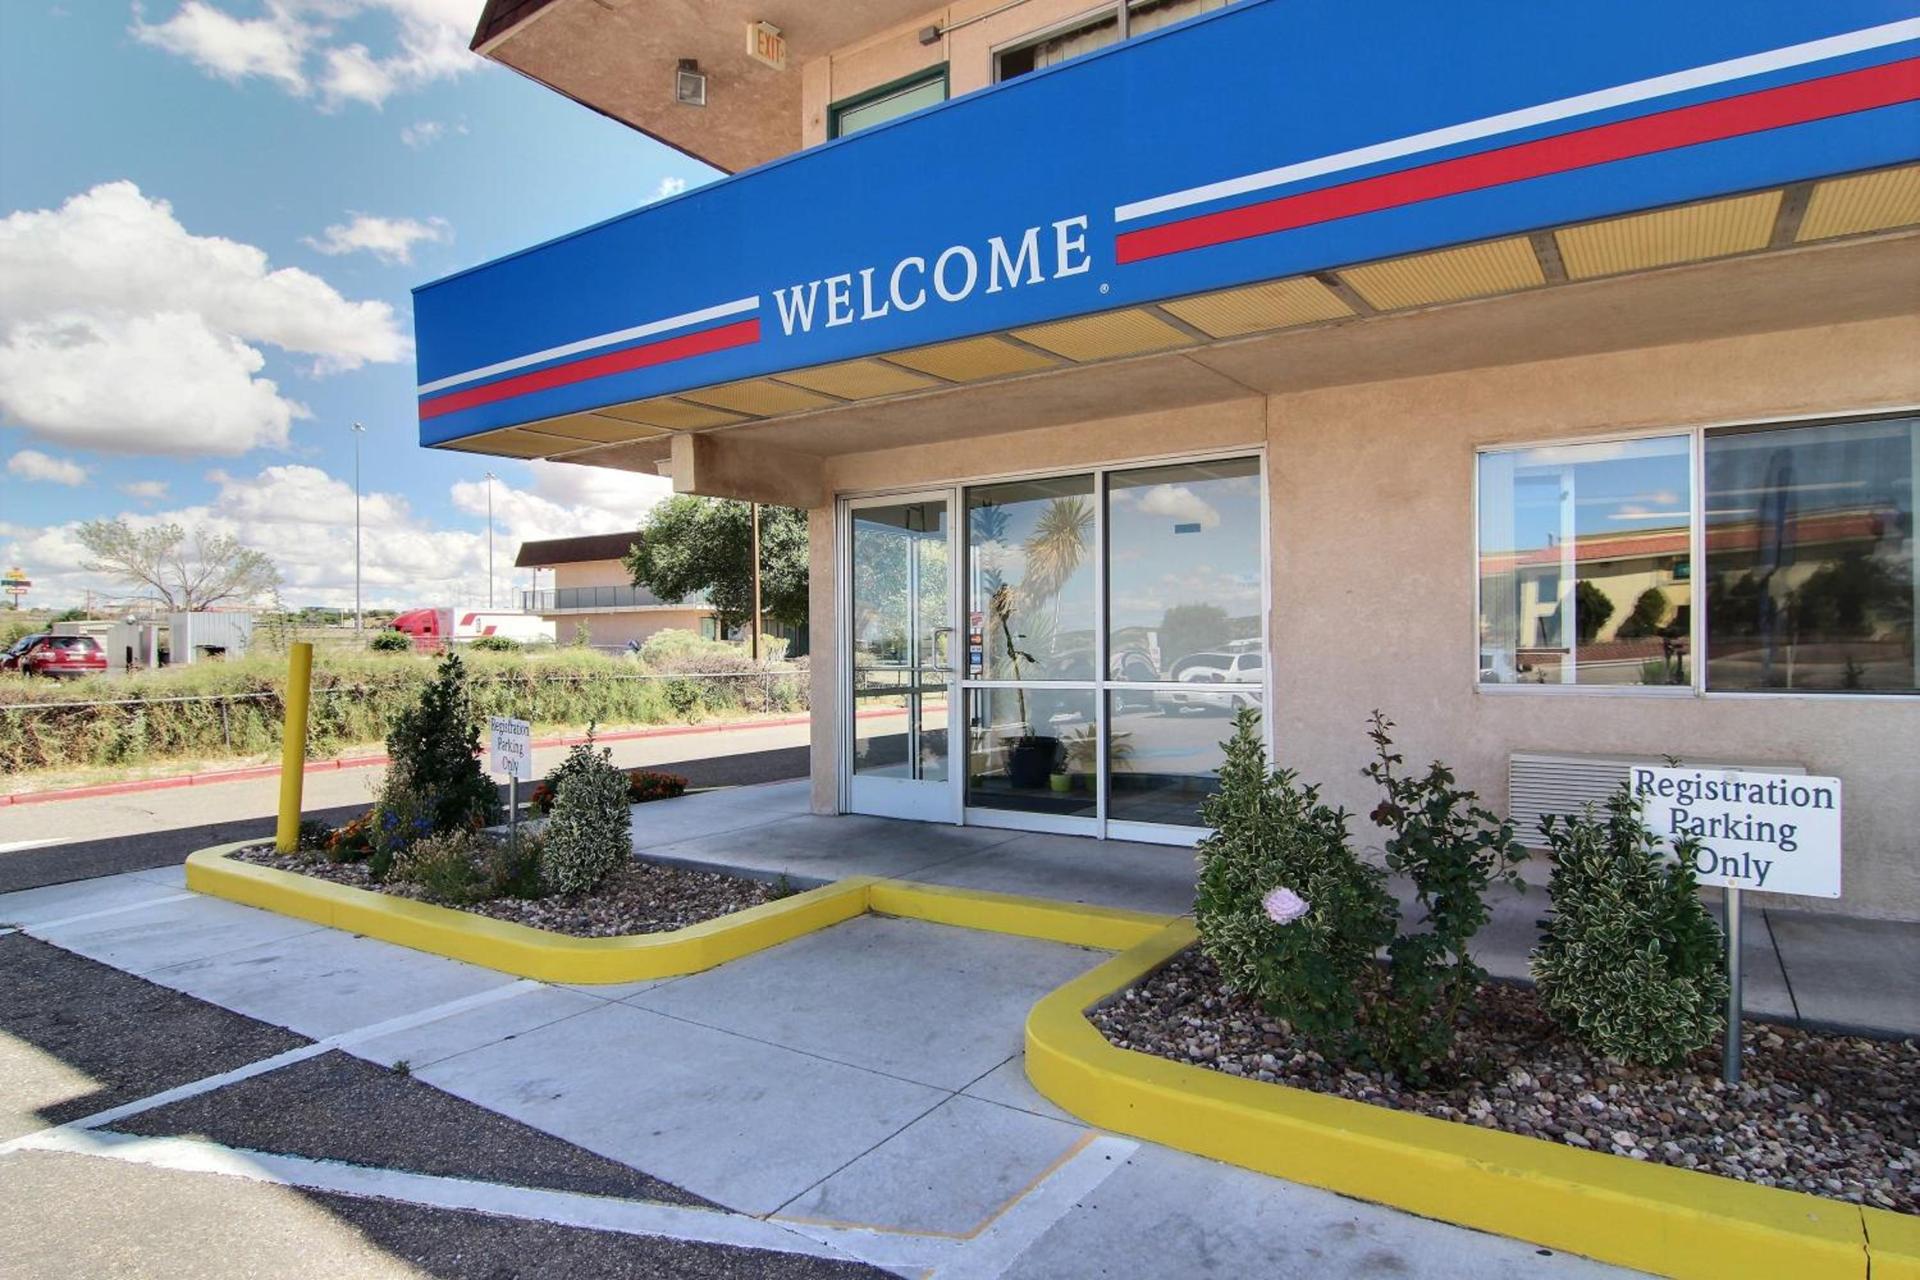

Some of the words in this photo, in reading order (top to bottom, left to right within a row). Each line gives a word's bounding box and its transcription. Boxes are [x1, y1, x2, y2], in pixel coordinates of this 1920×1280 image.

[773, 215, 1091, 336] WELCOME
[490, 717, 530, 737] Registration
[497, 737, 525, 759] Parking
[502, 755, 519, 775] Only
[1634, 769, 1836, 810] Registration
[1668, 807, 1798, 852] Parking
[1692, 846, 1774, 887] Only
